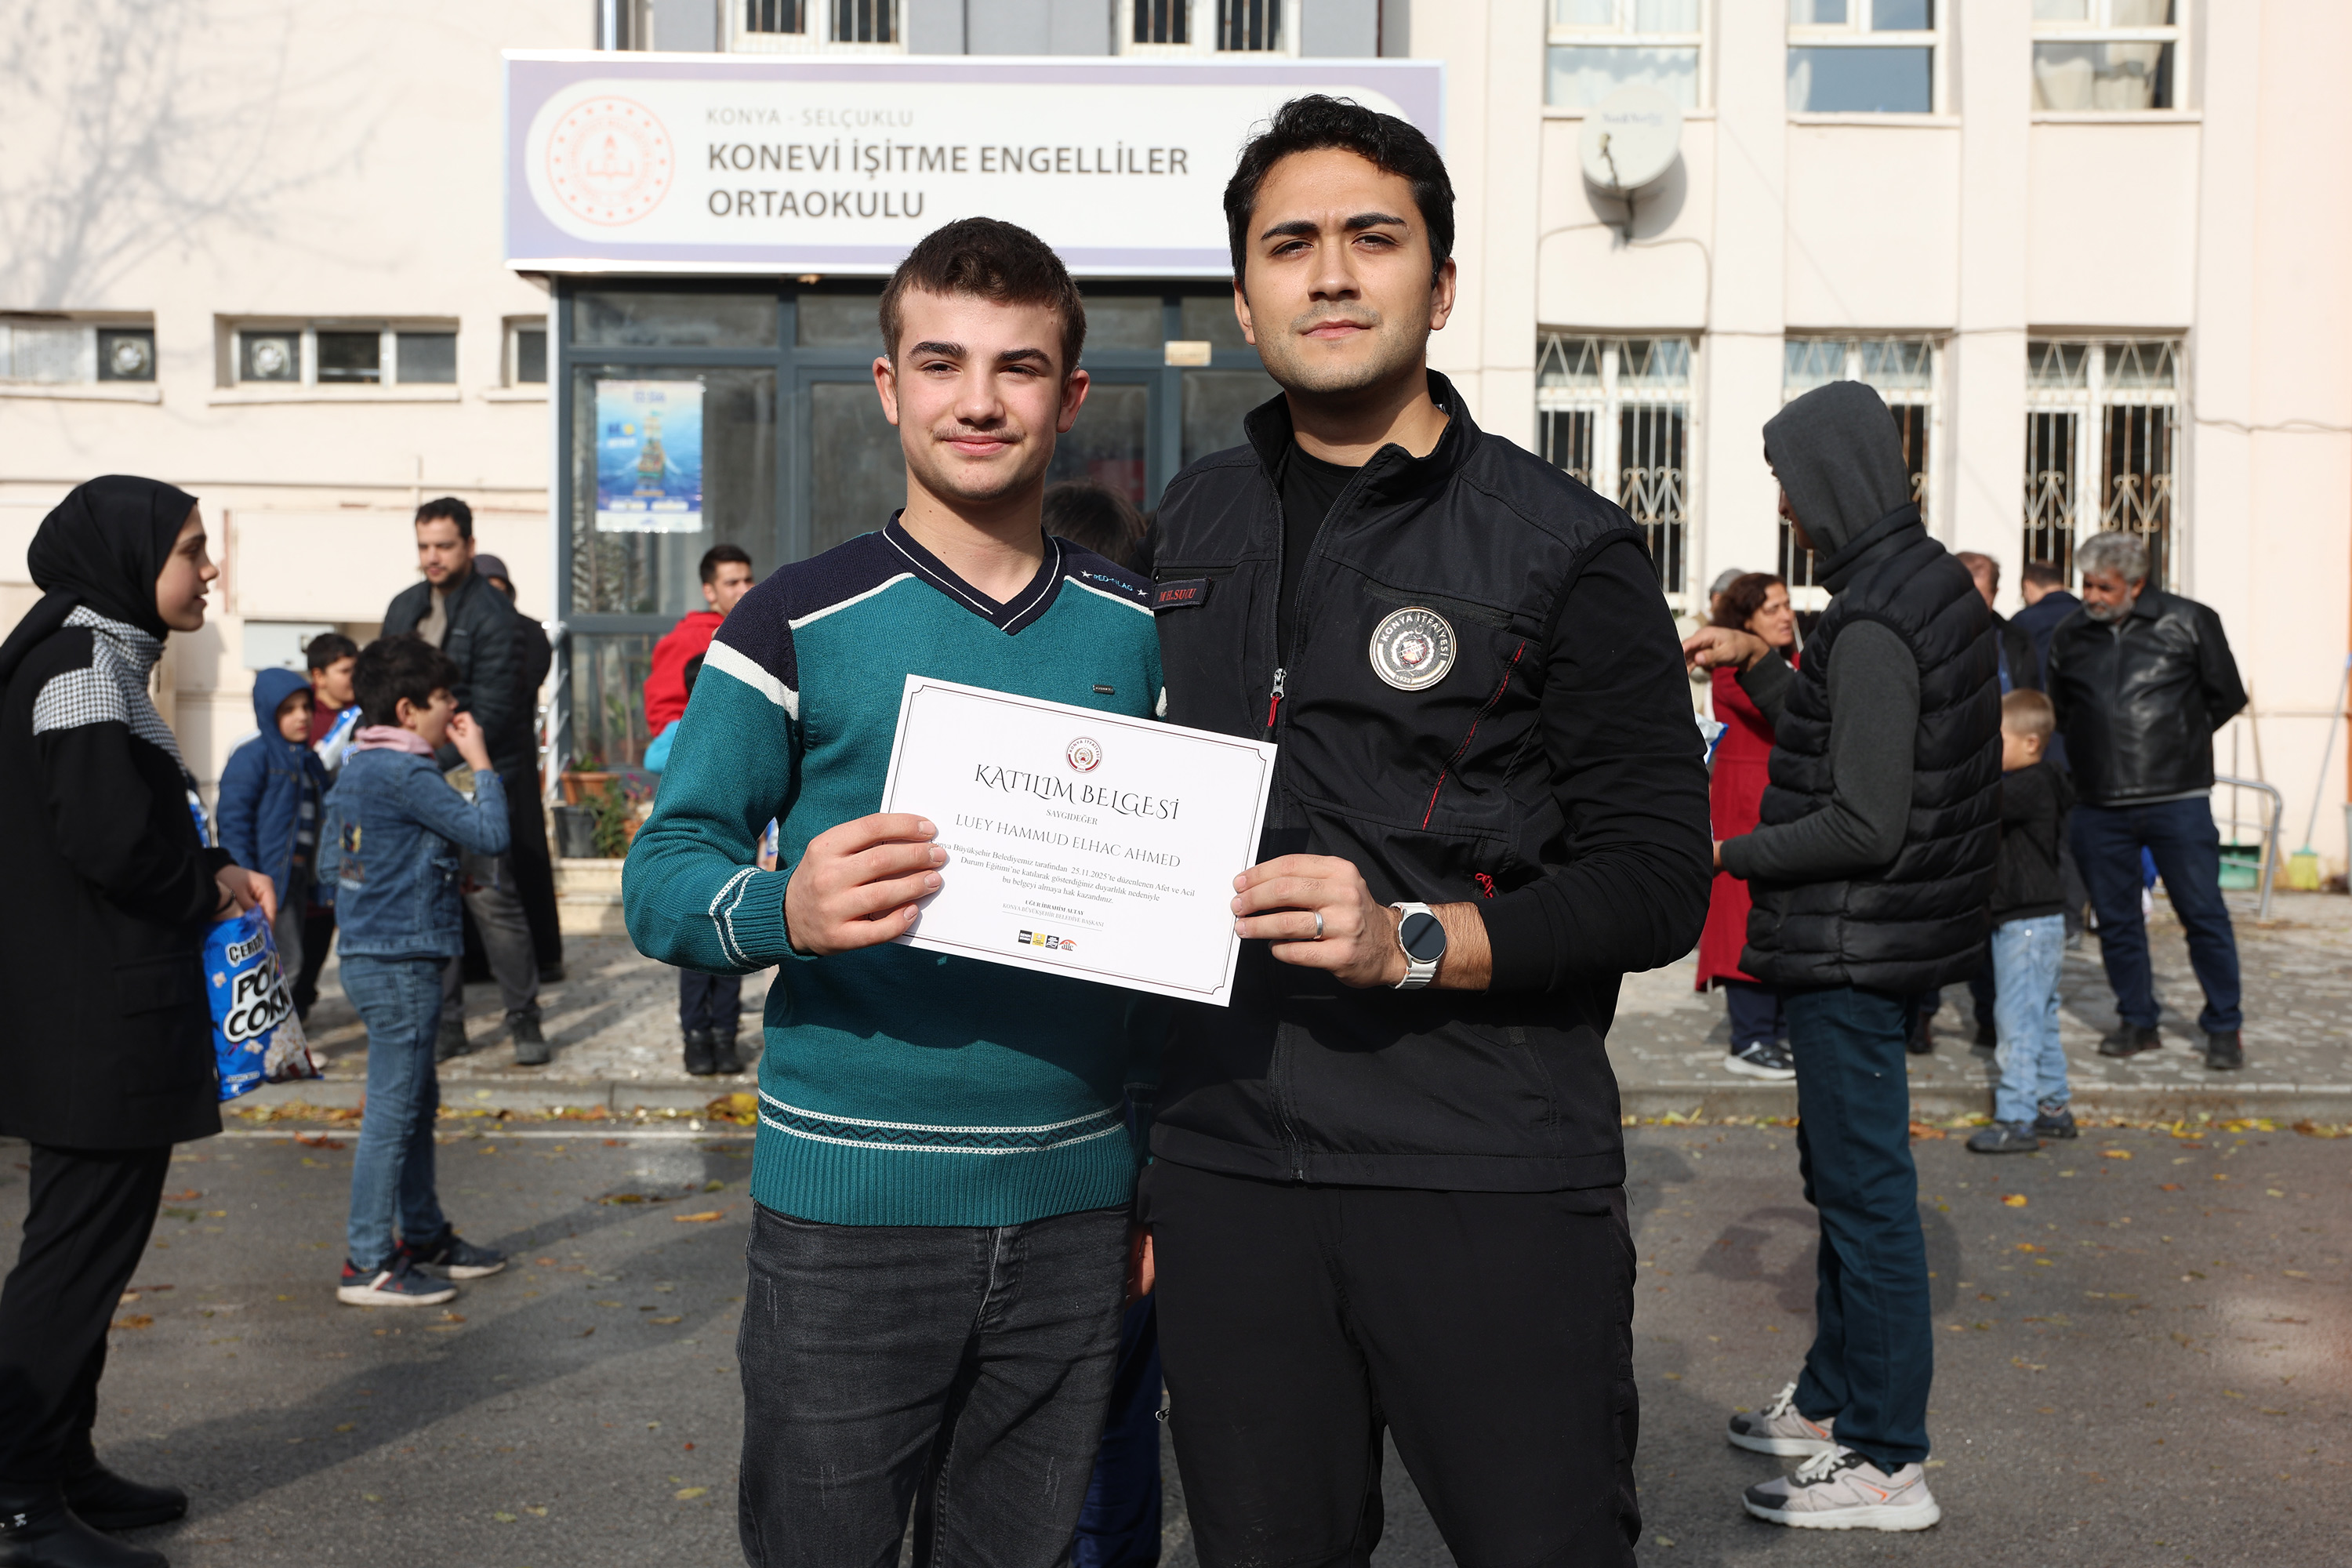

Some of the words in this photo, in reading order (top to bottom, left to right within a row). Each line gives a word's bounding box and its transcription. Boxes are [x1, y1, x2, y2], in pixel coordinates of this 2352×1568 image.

[706, 108, 781, 125] KONYA
[801, 109, 913, 130] SELÇUKLU
[709, 139, 839, 171] KONEVİ
[853, 139, 967, 180] İŞİTME
[981, 140, 1188, 175] ENGELLİLER
[708, 190, 924, 218] ORTAOKULU
[1381, 615, 1413, 642] KONYA
[1416, 612, 1449, 657] İTFAİYESİ
[1069, 739, 1083, 753] KONYA
[975, 764, 1076, 804] KATILIM
[1080, 784, 1179, 820] BELGESİ
[1046, 809, 1098, 825] SAYGIDEĞER
[956, 814, 993, 831] LUEY
[996, 822, 1069, 846] HAMMUD
[1073, 837, 1121, 856] ELHAC
[1124, 848, 1181, 867] AHMED
[953, 844, 991, 858] Büyükşehir
[993, 851, 1033, 866] Belediyemiz
[1035, 860, 1067, 873] tarafından
[1117, 876, 1154, 889] düzenlenen
[1155, 884, 1170, 892] Afet
[1181, 888, 1196, 897] Acil
[960, 857, 984, 867] Durum
[1022, 867, 1054, 880] katılarak
[1051, 875, 1094, 888] gösterdiğiniz
[1095, 883, 1127, 895] duyarlılık
[1128, 890, 1160, 902] nedeniyle
[1002, 876, 1011, 884] bu
[1012, 878, 1036, 890] belgeyi
[1037, 884, 1062, 895] almaya
[1063, 887, 1076, 896] hak
[1081, 917, 1105, 927] BAŞKANI
